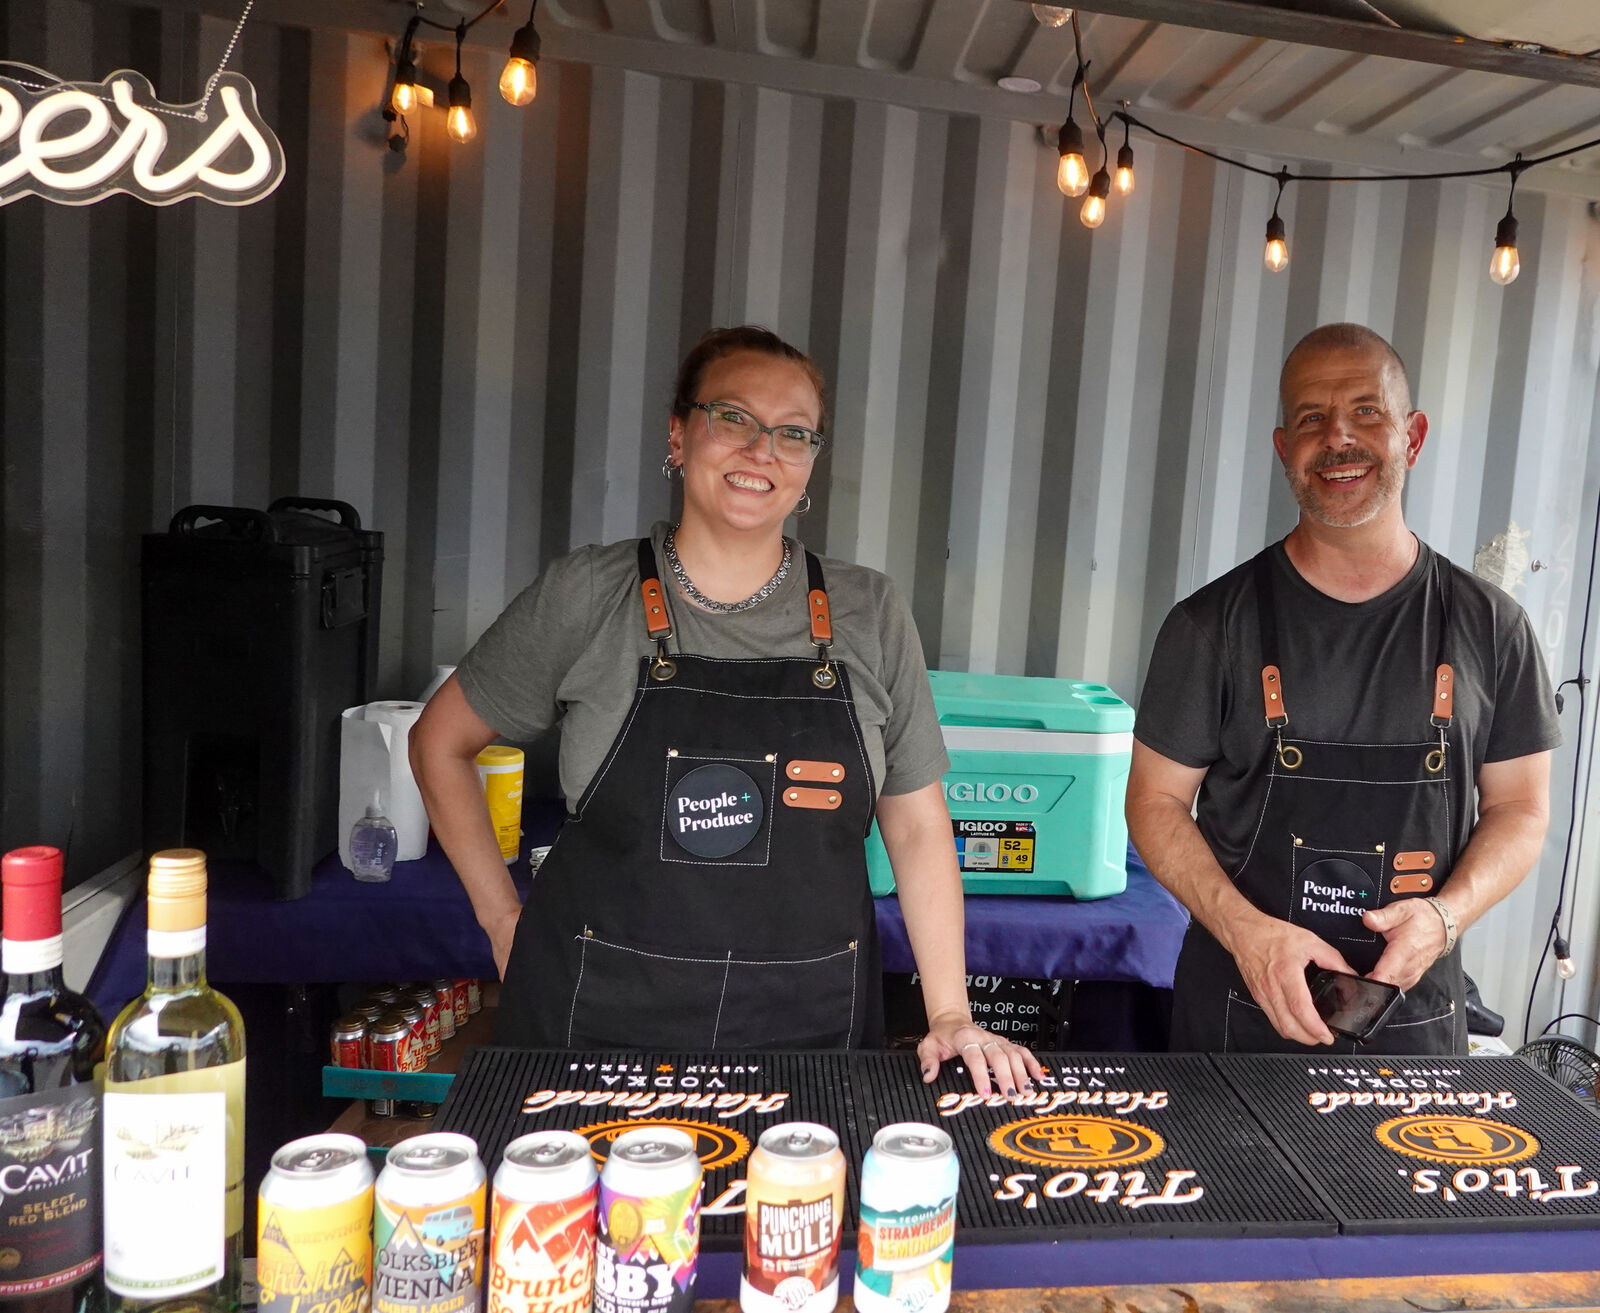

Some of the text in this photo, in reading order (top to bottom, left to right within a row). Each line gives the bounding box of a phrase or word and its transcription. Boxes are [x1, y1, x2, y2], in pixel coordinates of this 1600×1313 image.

[678, 792, 737, 814] People
[679, 812, 754, 833] Produce
[959, 821, 1007, 832] IGLOO
[1004, 841, 1021, 850] 52
[1015, 854, 1028, 862] 49
[1303, 880, 1356, 900] People
[1301, 897, 1367, 917] Produce
[969, 1001, 991, 1013] the
[994, 1001, 1015, 1015] QR
[973, 1019, 988, 1031] re
[991, 1019, 1008, 1031] all
[600, 1075, 726, 1089] VODKA
[1343, 1078, 1452, 1089] VODKA
[521, 1089, 790, 1118] Handmade
[936, 1091, 1169, 1116] Handmade
[1308, 1091, 1518, 1114] Handmade
[0, 1148, 94, 1195] CAVIT
[8, 1198, 88, 1227] RED BLEND
[23, 1192, 76, 1215] SELECT
[760, 1197, 832, 1236] PUNCHING
[898, 1207, 941, 1225] TEQUILA
[760, 1215, 832, 1257] MULE
[0, 1280, 44, 1293] PORTED
[259, 1255, 367, 1305] ightshine
[374, 1266, 474, 1301] VIENNA
[596, 1254, 684, 1301] BBY
